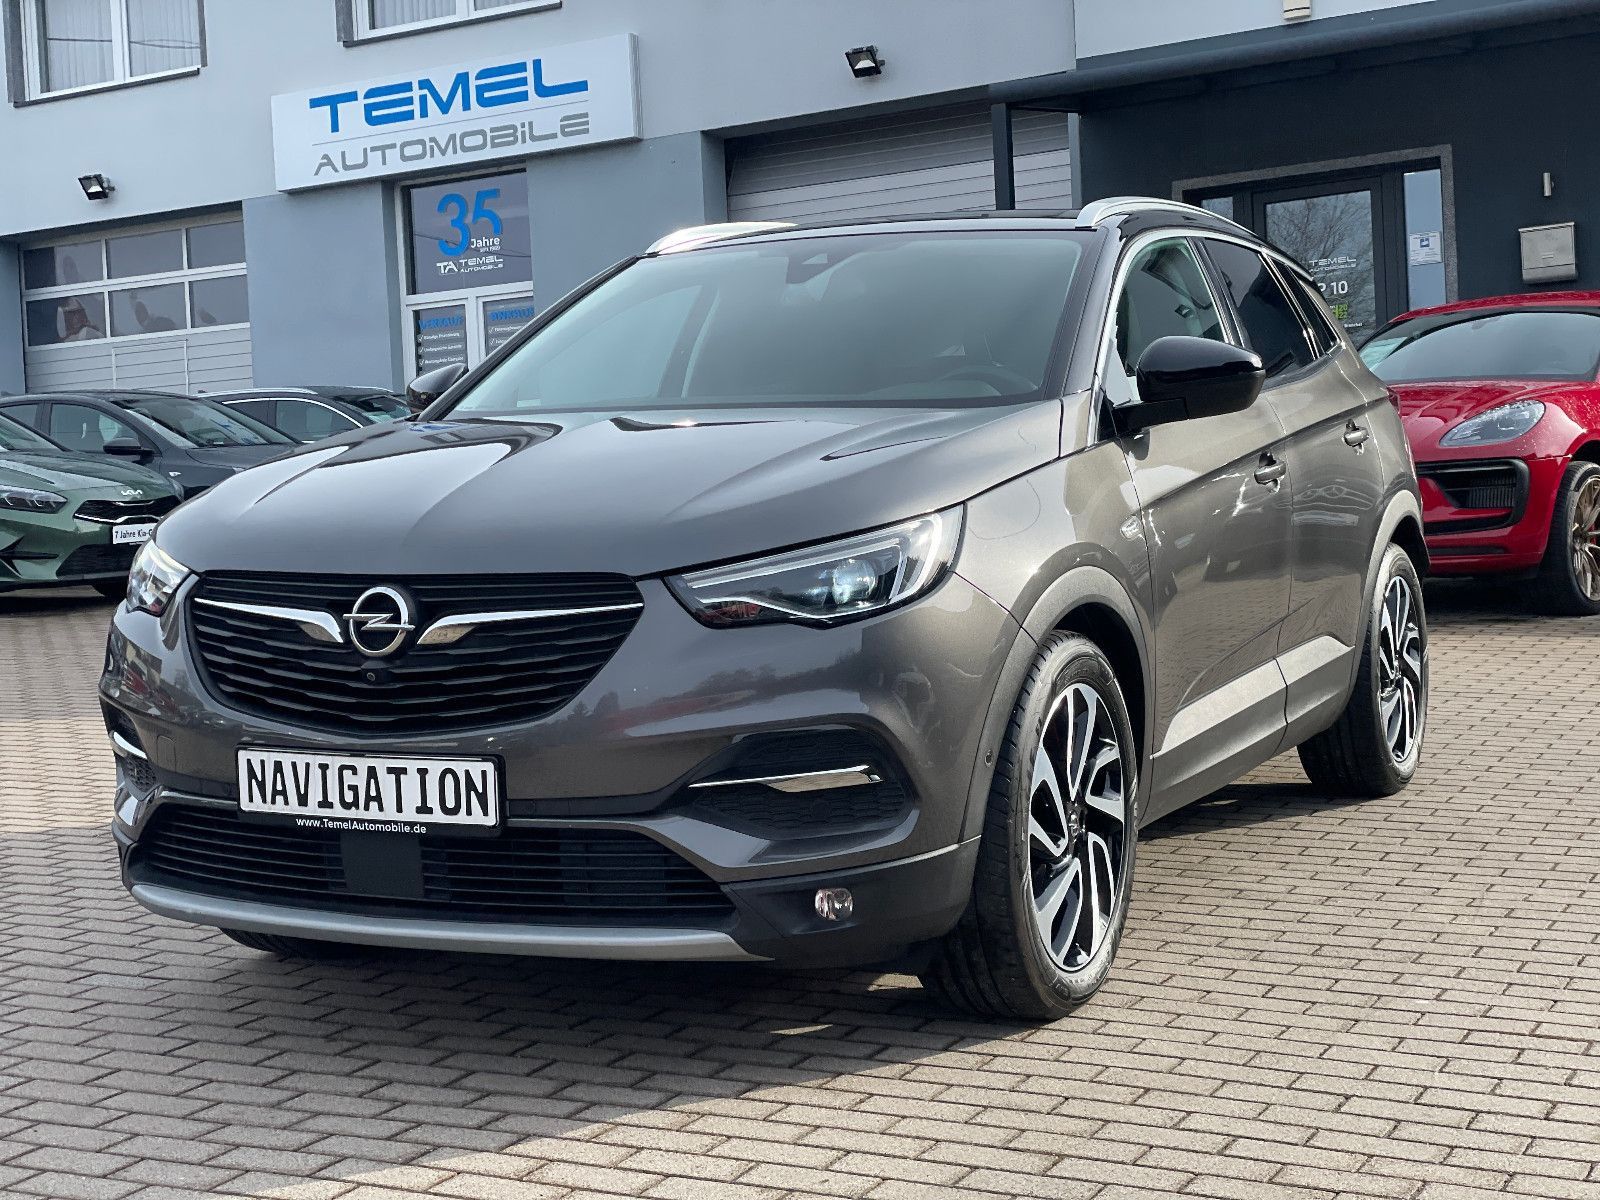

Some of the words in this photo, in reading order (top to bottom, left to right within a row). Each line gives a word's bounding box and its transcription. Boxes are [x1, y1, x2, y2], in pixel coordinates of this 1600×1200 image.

[309, 58, 589, 133] TEMEL
[437, 188, 503, 256] 35
[470, 237, 501, 249] Jahre
[459, 255, 504, 267] TEMEL
[1309, 256, 1357, 267] TEMEL
[1330, 281, 1349, 295] 10
[114, 531, 119, 539] 7
[120, 530, 136, 539] Jahre
[246, 758, 490, 817] NAVIGATION
[296, 818, 427, 834] www.TemelAutomobile.de
